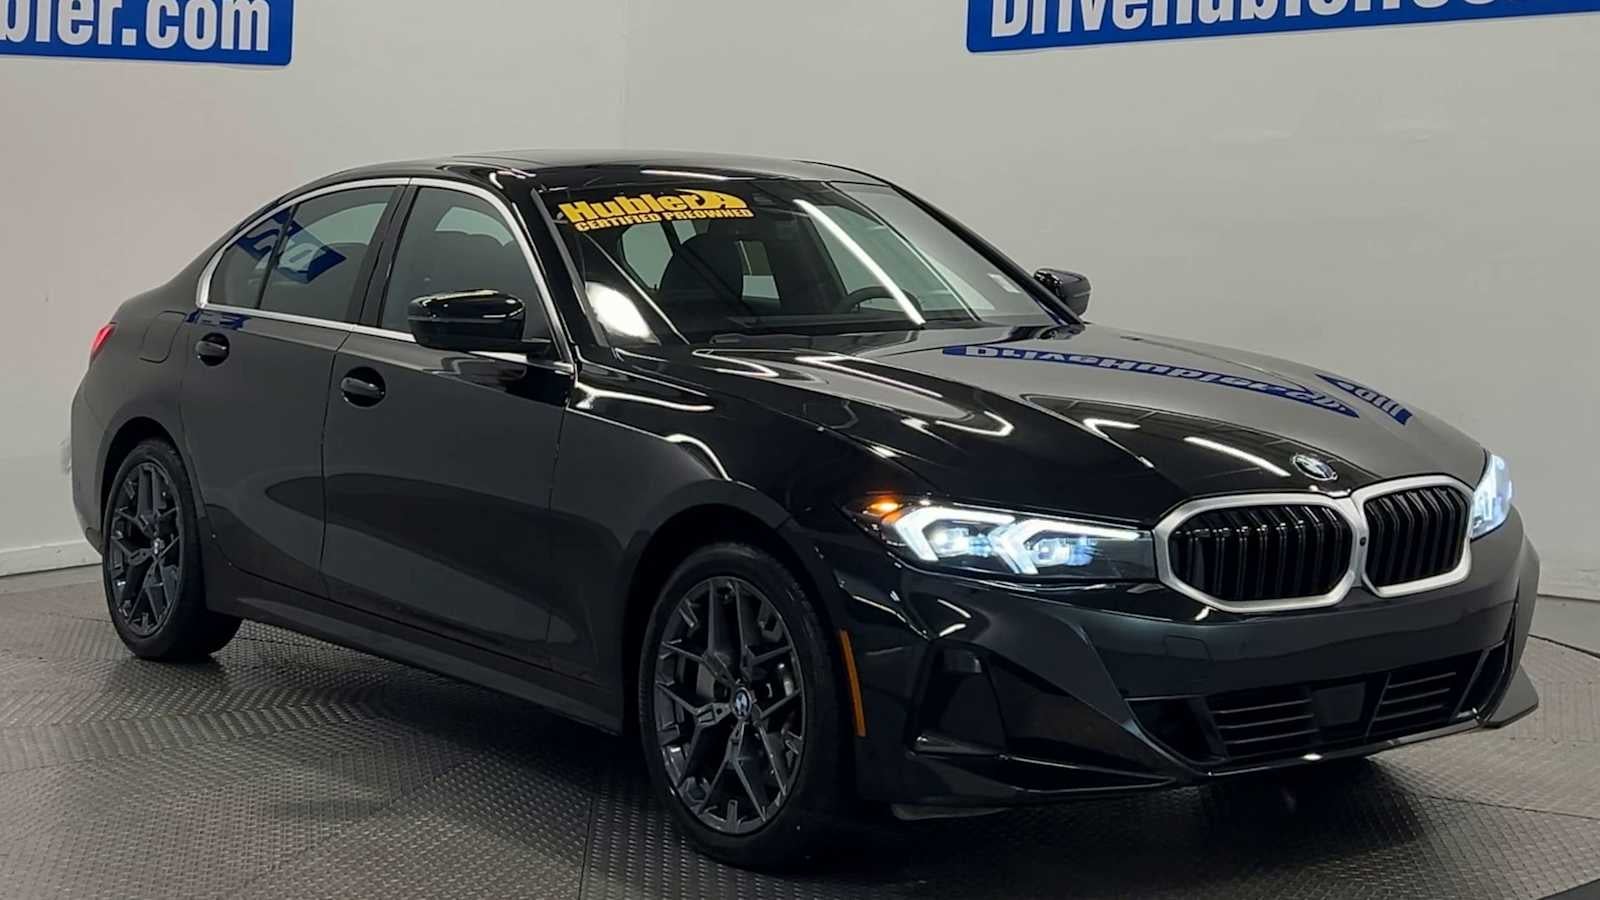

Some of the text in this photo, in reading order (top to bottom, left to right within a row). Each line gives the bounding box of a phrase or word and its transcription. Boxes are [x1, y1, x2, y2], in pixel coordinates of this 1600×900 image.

[558, 193, 704, 223] Hubler
[573, 209, 754, 232] CERTIFIED PREOWNED
